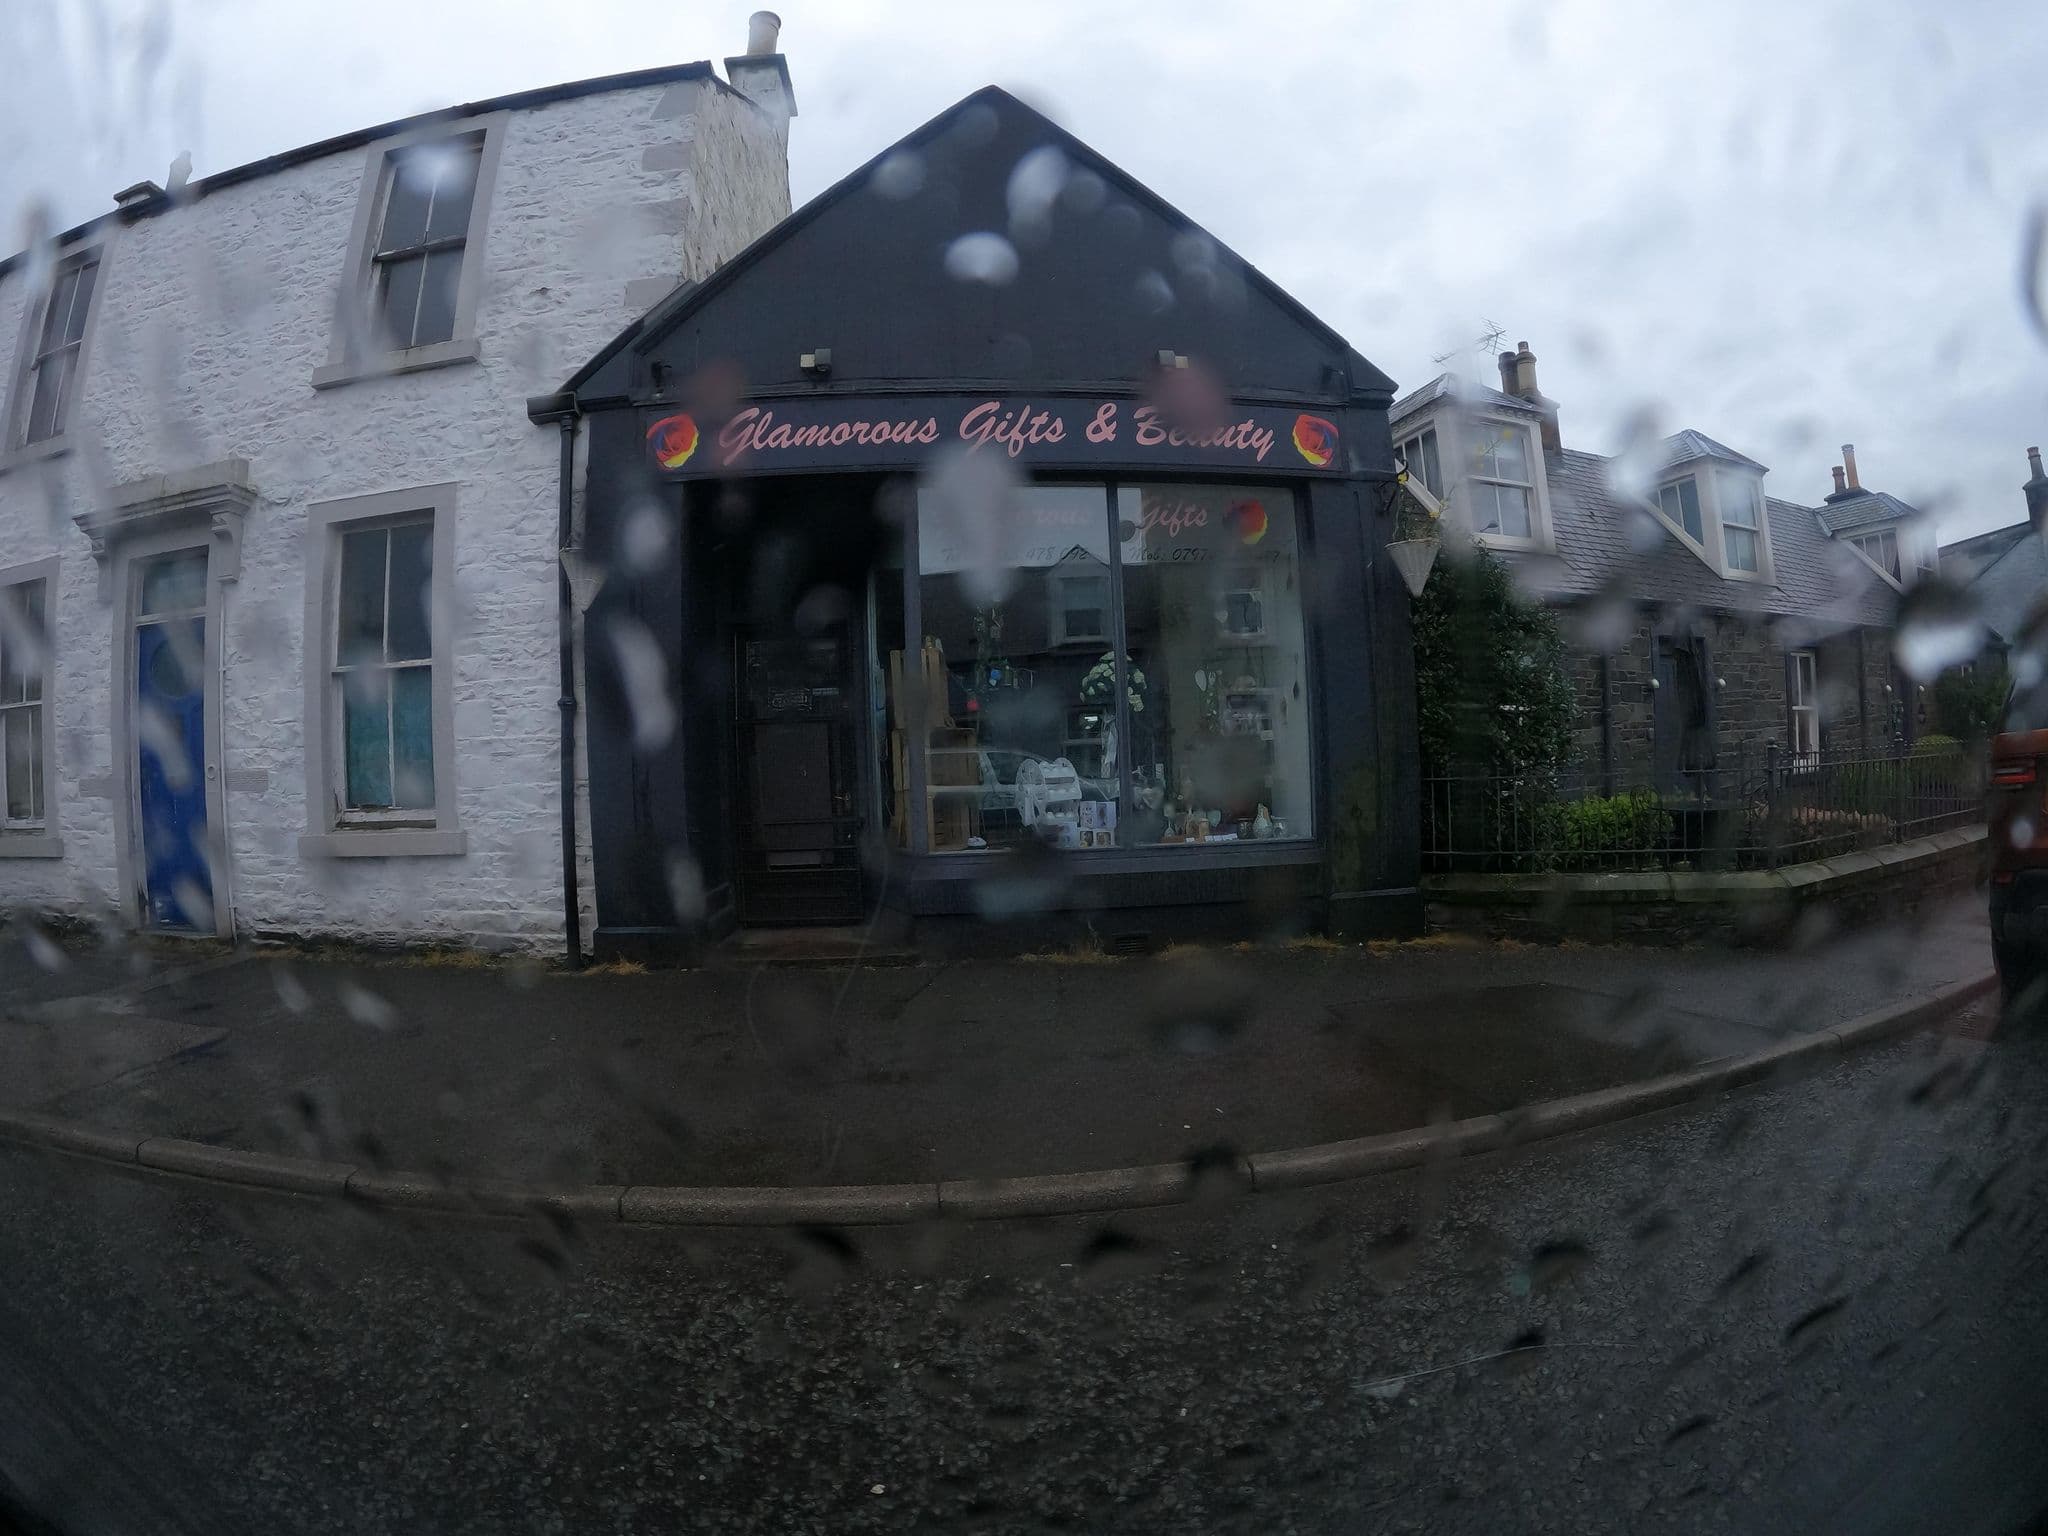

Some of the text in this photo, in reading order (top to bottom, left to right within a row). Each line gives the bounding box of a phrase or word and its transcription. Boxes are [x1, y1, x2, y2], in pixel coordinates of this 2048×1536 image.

[719, 407, 940, 466] Glamorous
[959, 401, 1067, 457] Gifts
[1085, 402, 1119, 443] &
